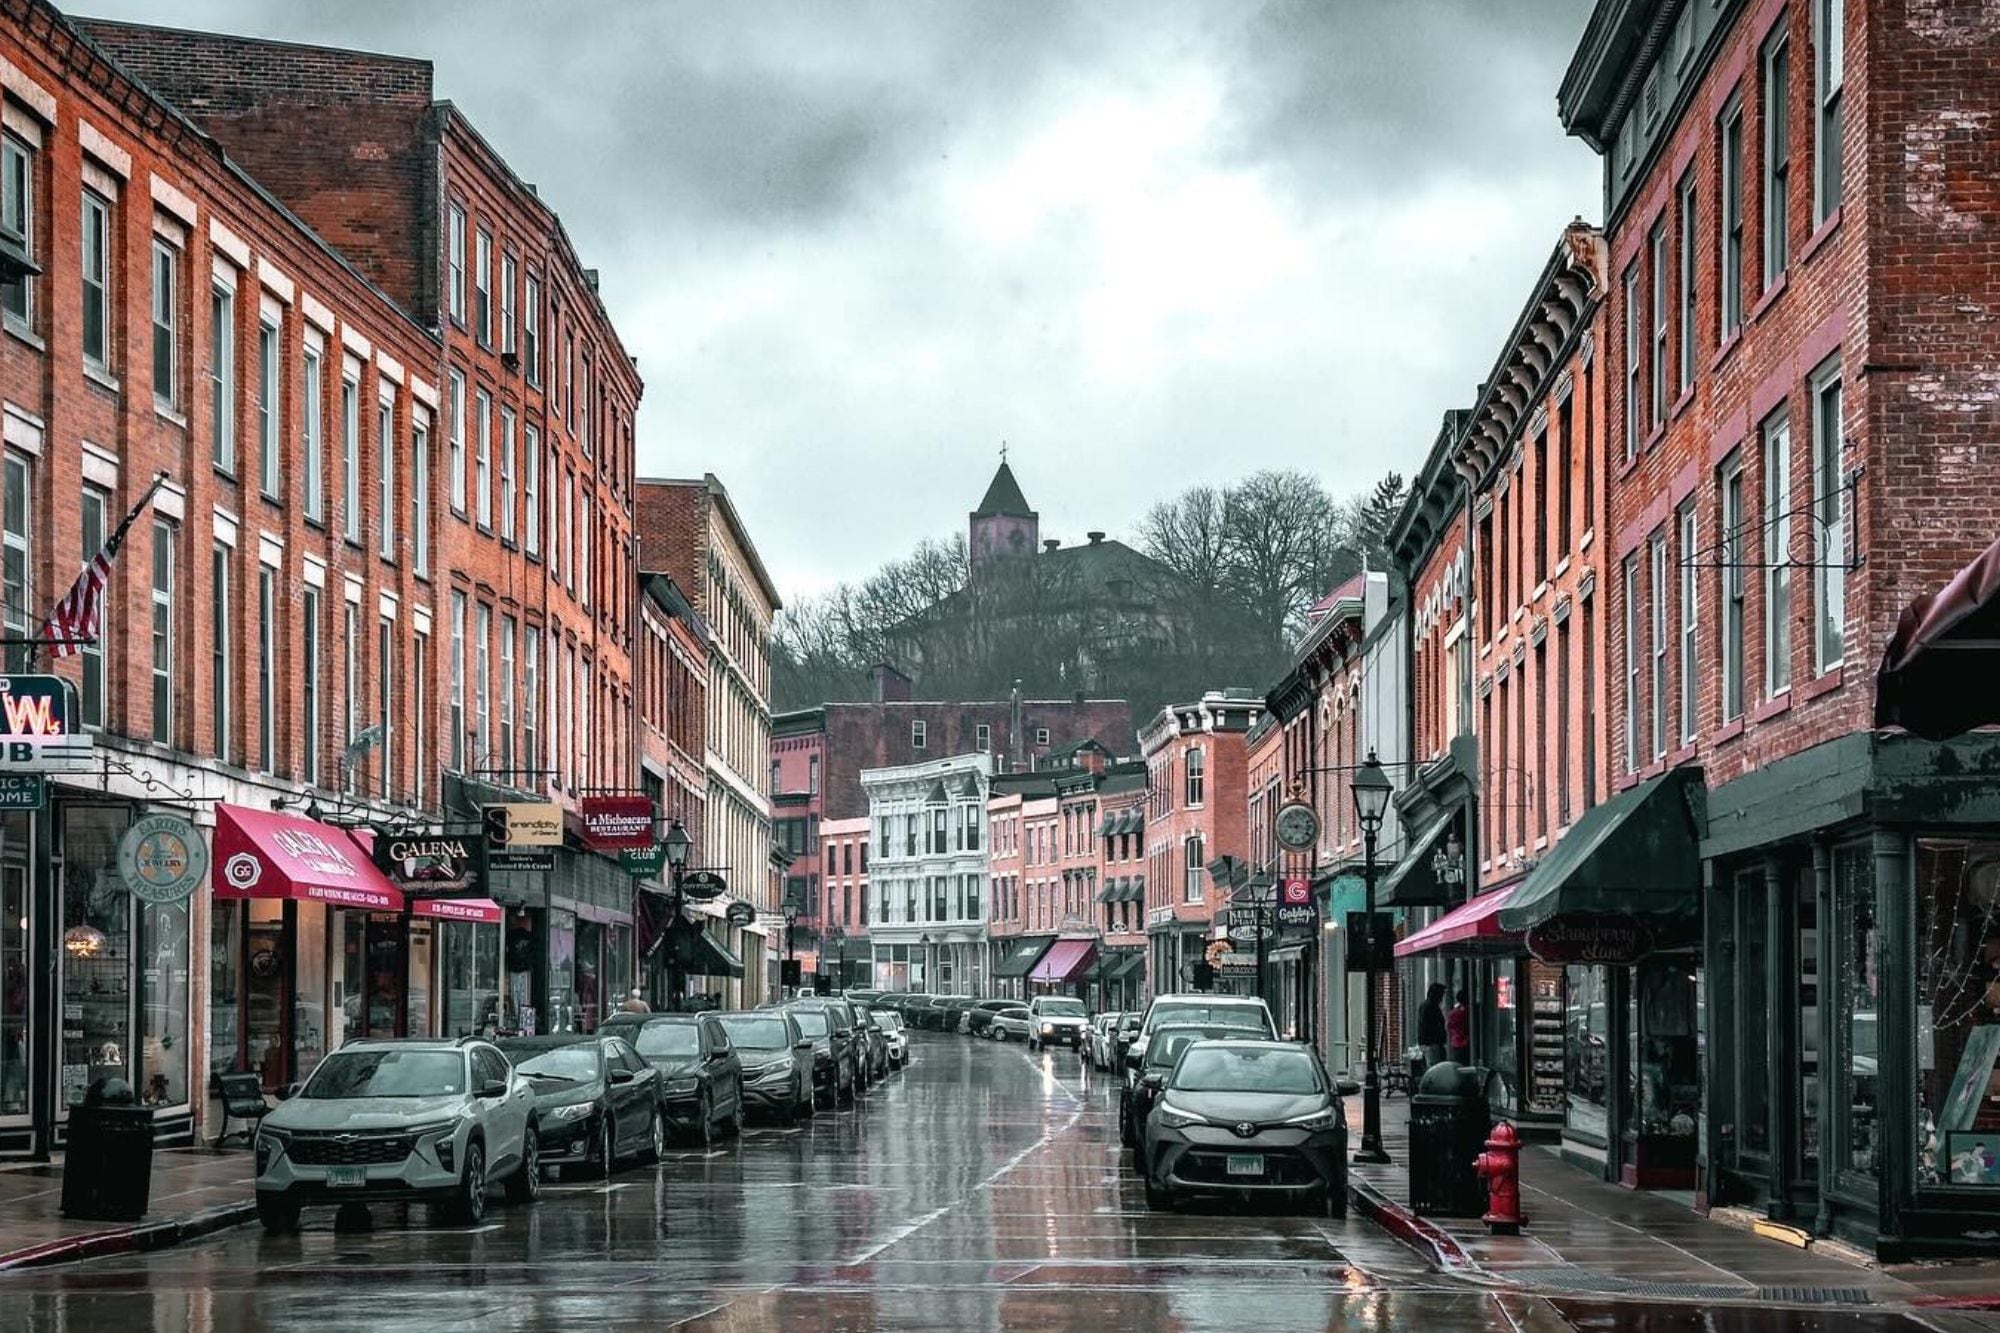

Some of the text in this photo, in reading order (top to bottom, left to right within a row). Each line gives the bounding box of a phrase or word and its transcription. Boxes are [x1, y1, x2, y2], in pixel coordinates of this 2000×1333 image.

[139, 817, 190, 836] EARTH'S
[586, 814, 652, 825] La Michoacana
[390, 841, 469, 861] GALENA
[1289, 882, 1306, 900] G
[1279, 906, 1316, 924] Gabby's
